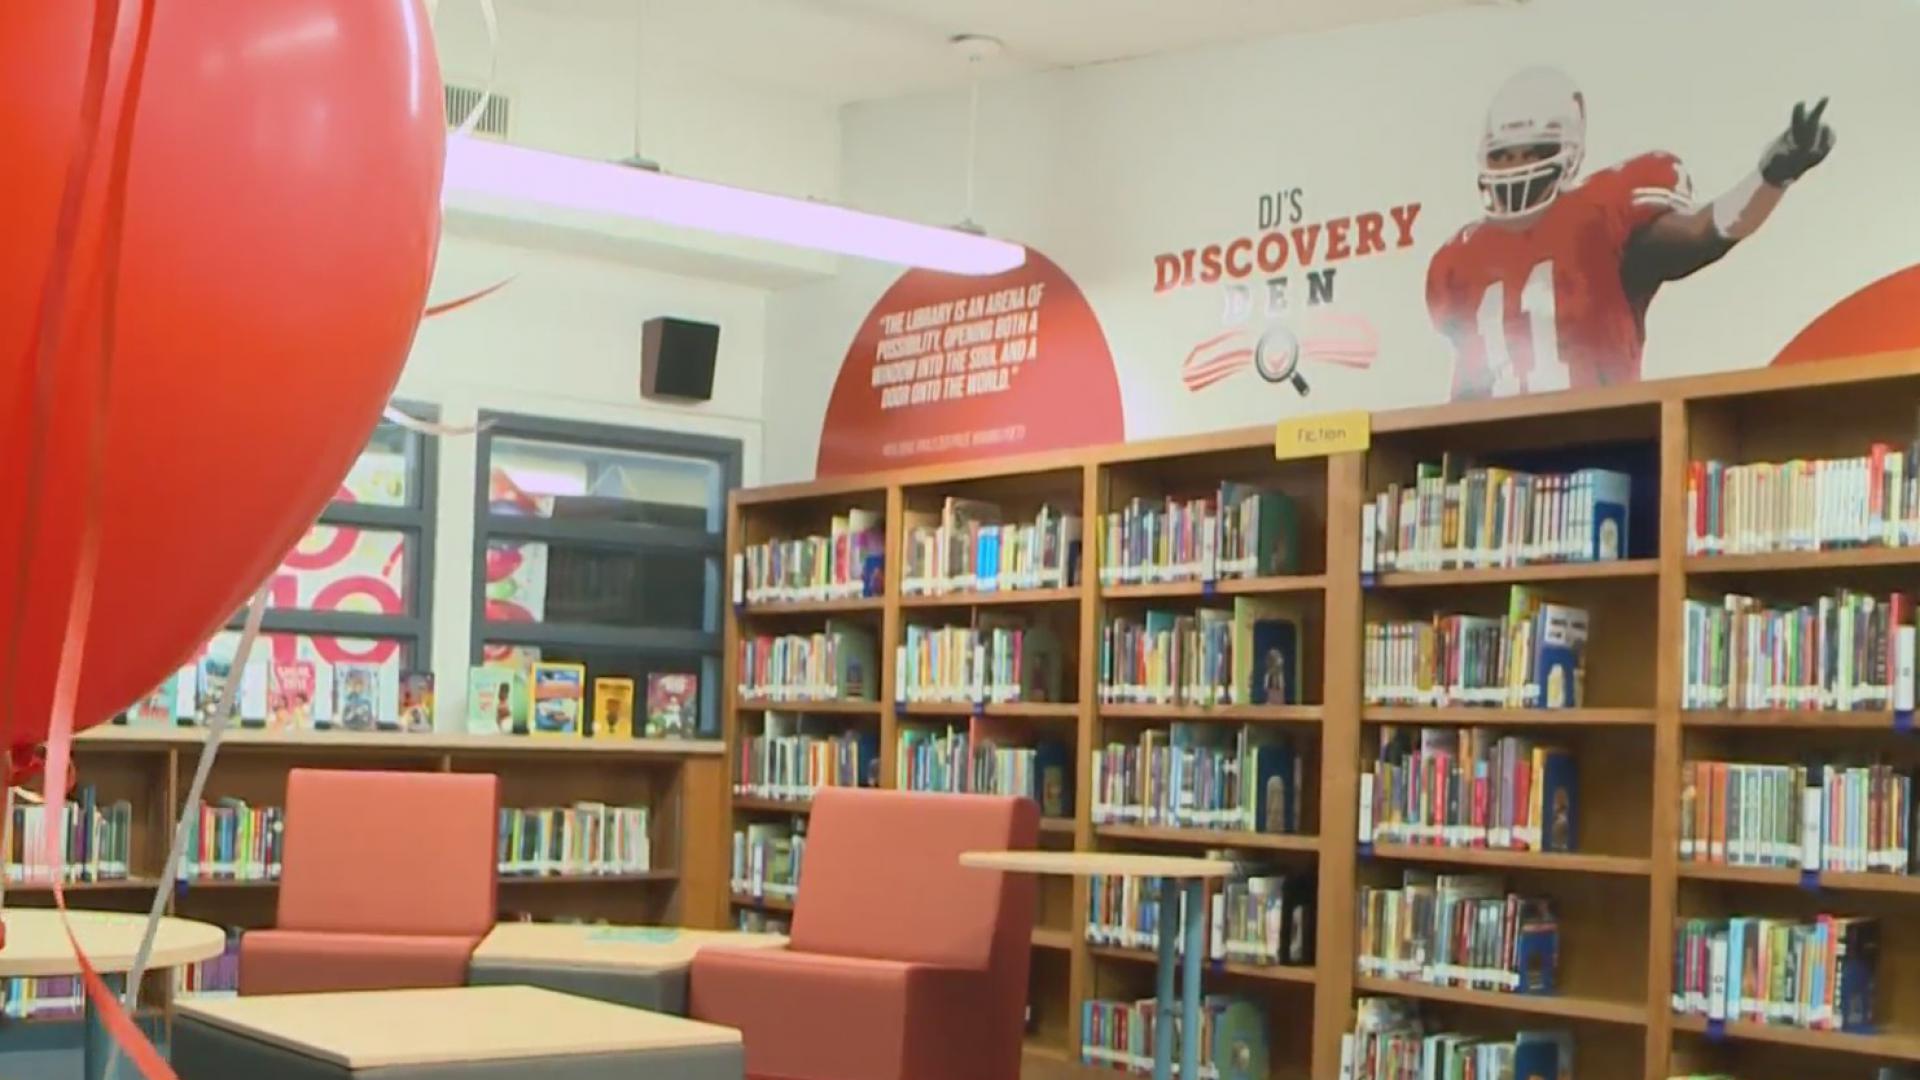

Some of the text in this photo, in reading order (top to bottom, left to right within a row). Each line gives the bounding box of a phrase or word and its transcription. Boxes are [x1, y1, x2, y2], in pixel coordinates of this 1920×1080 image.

[1258, 187, 1302, 230] DJ'S
[1153, 202, 1421, 293] DISCOVERY
[906, 302, 953, 331] LIBRARY
[953, 298, 966, 322] IS
[967, 295, 985, 319] AN
[985, 286, 1026, 317] ARENA
[1027, 282, 1045, 307] OF
[1222, 268, 1337, 325] DEN
[1476, 259, 1571, 398] 11
